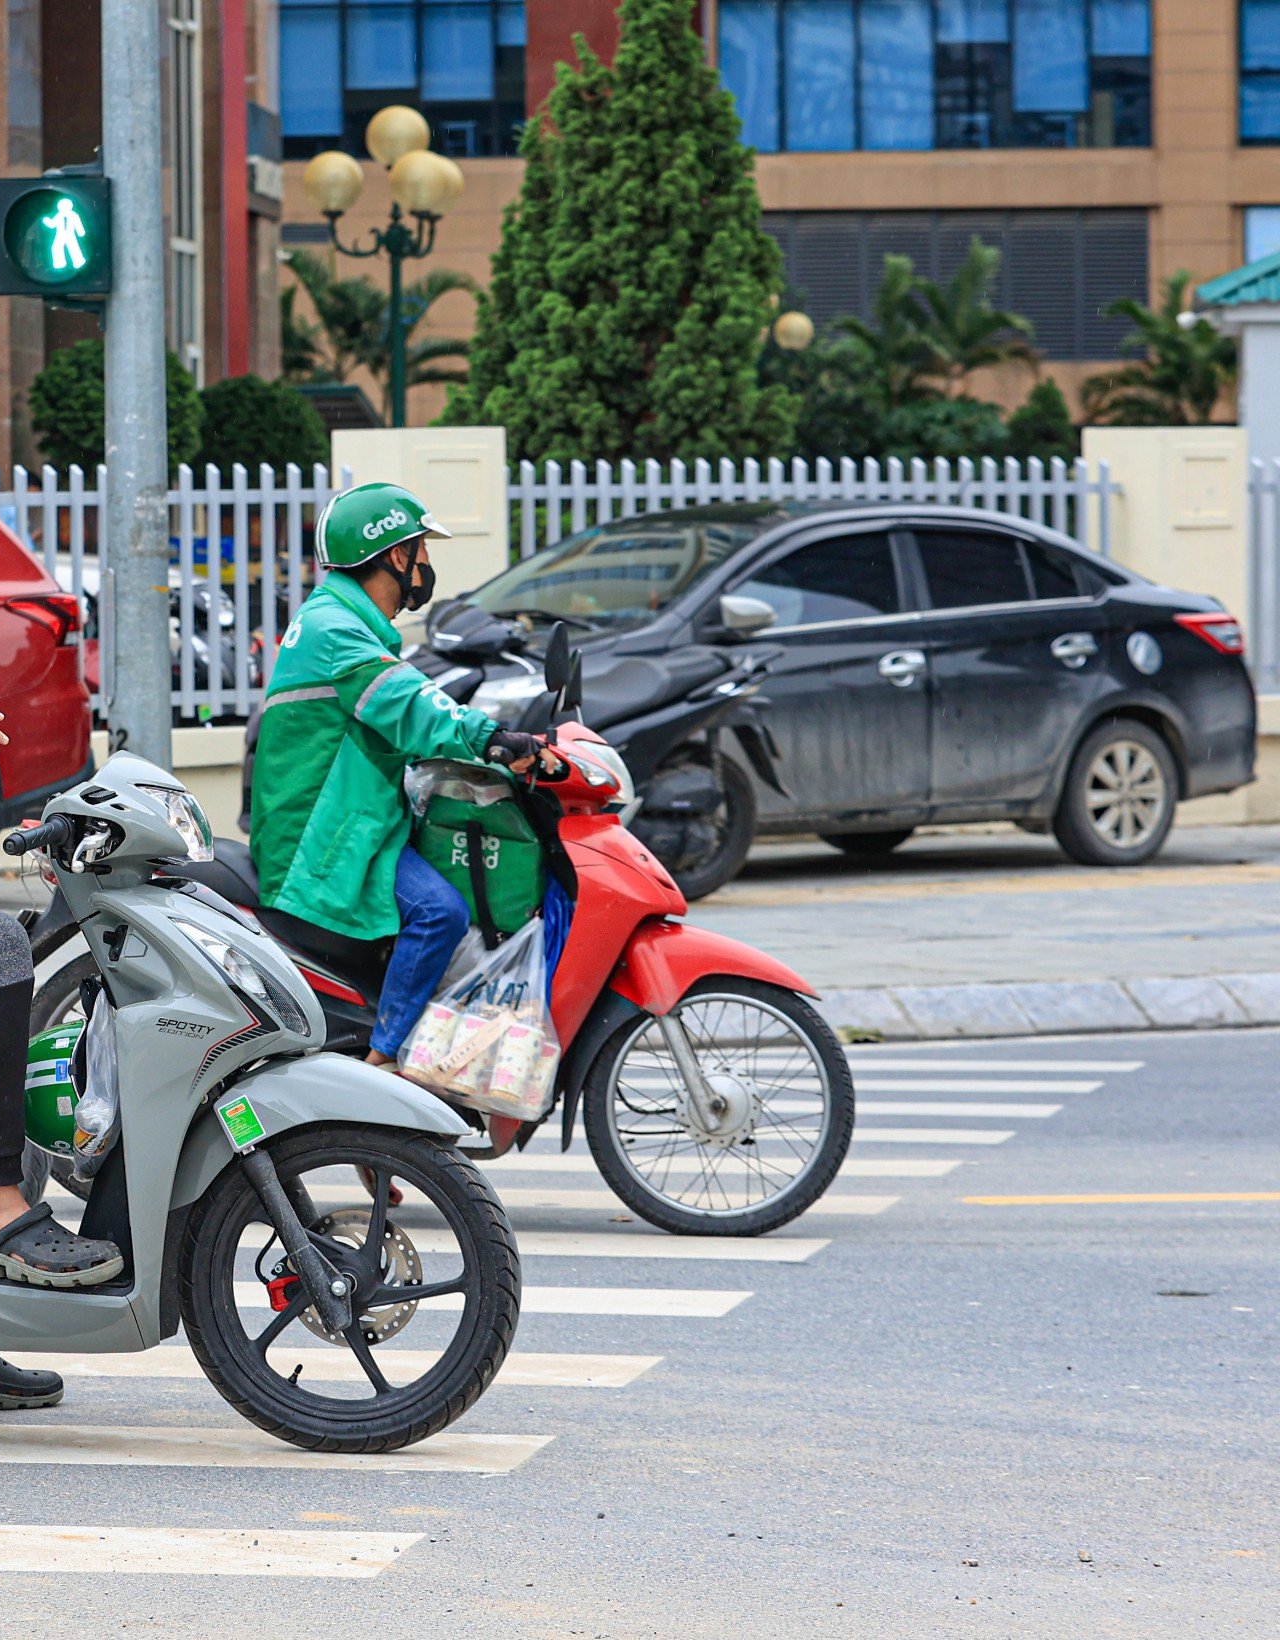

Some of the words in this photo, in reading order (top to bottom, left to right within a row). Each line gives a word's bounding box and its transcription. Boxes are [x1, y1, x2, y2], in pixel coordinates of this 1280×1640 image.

[362, 508, 407, 540] Grab
[451, 849, 499, 869] Fod
[156, 1017, 216, 1035] SPORTY
[158, 1028, 205, 1040] EDITION
